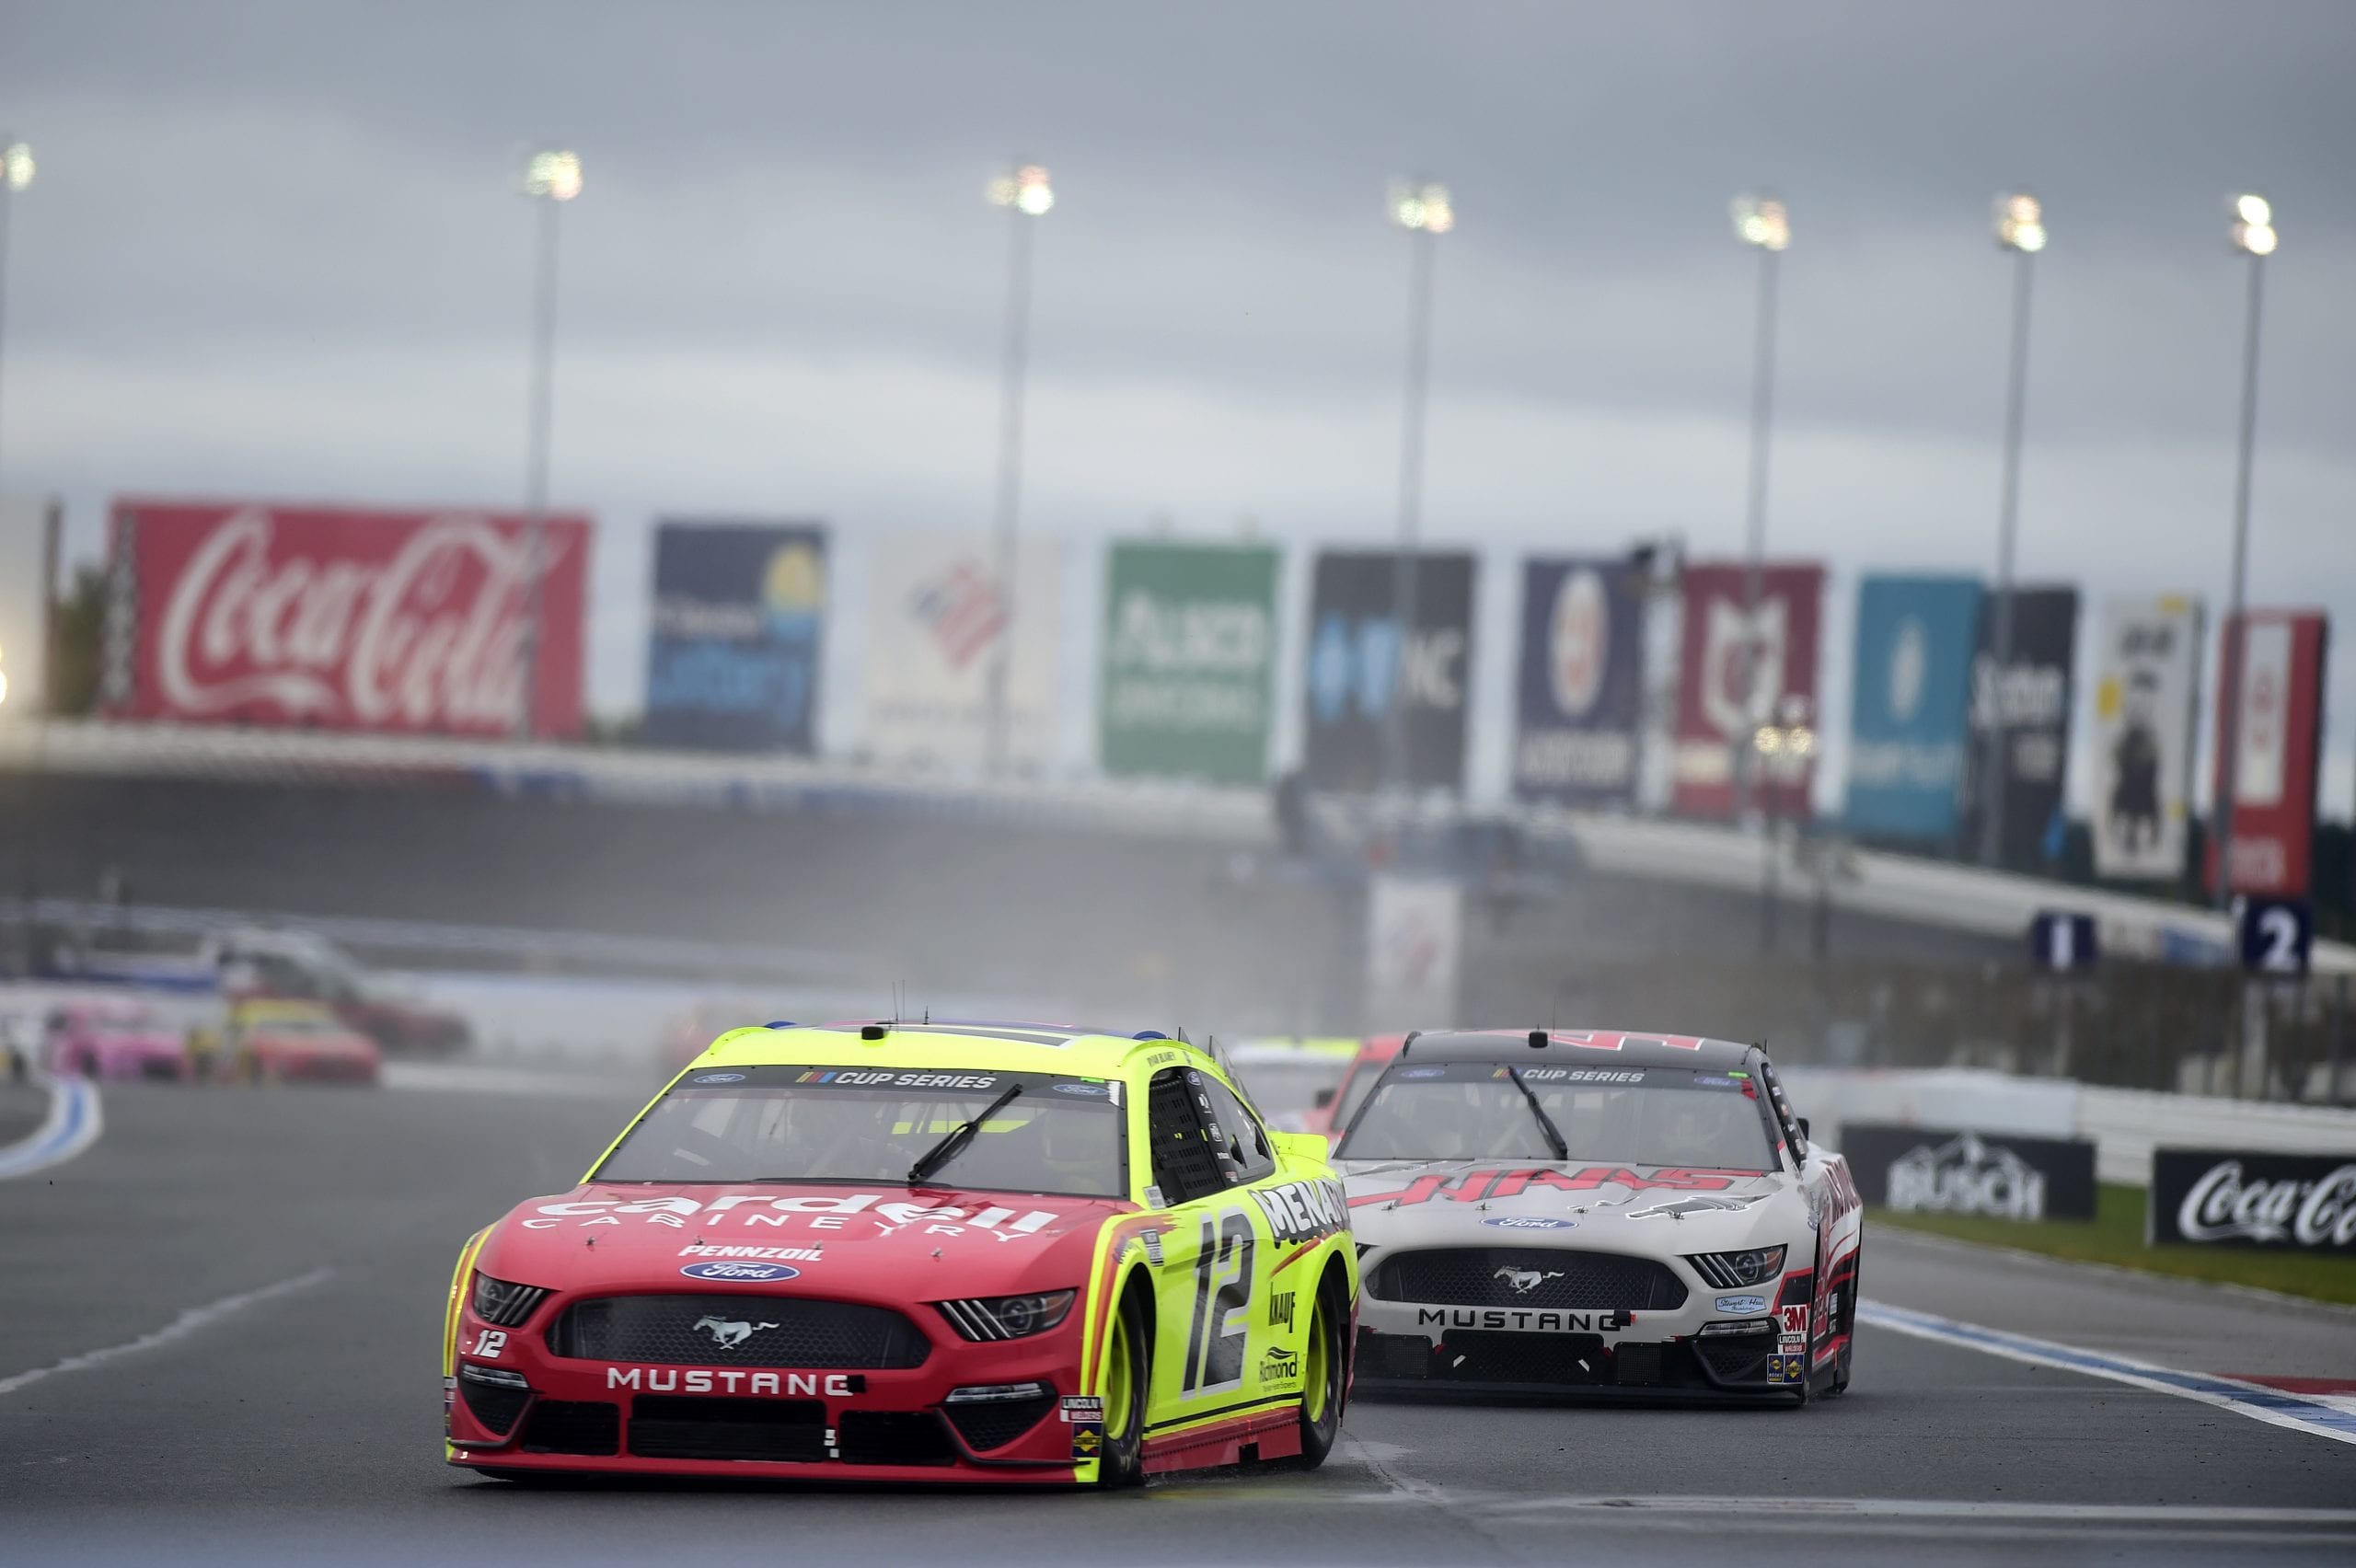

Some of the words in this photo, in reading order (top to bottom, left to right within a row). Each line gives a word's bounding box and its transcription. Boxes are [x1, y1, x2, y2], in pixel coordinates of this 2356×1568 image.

[2050, 917, 2073, 971] 1
[2258, 906, 2299, 972] 2
[834, 1071, 894, 1086] CUP
[894, 1073, 998, 1090] SERIES
[1523, 1069, 1566, 1080] CUP
[1568, 1070, 1646, 1083] SERIES
[1498, 1216, 1560, 1228] Ford
[677, 1245, 824, 1262] PENNZOIL
[701, 1262, 778, 1278] Ford
[1180, 1205, 1255, 1402] 12
[1268, 1281, 1296, 1334] KNAUF
[1418, 1308, 1621, 1332] MUSTANG
[1784, 1307, 1807, 1332] 3M
[472, 1330, 507, 1359] 12
[1779, 1334, 1801, 1344] LINCOLN
[606, 1366, 854, 1397] MUSTANG
[1062, 1398, 1099, 1409] LINCOLN
